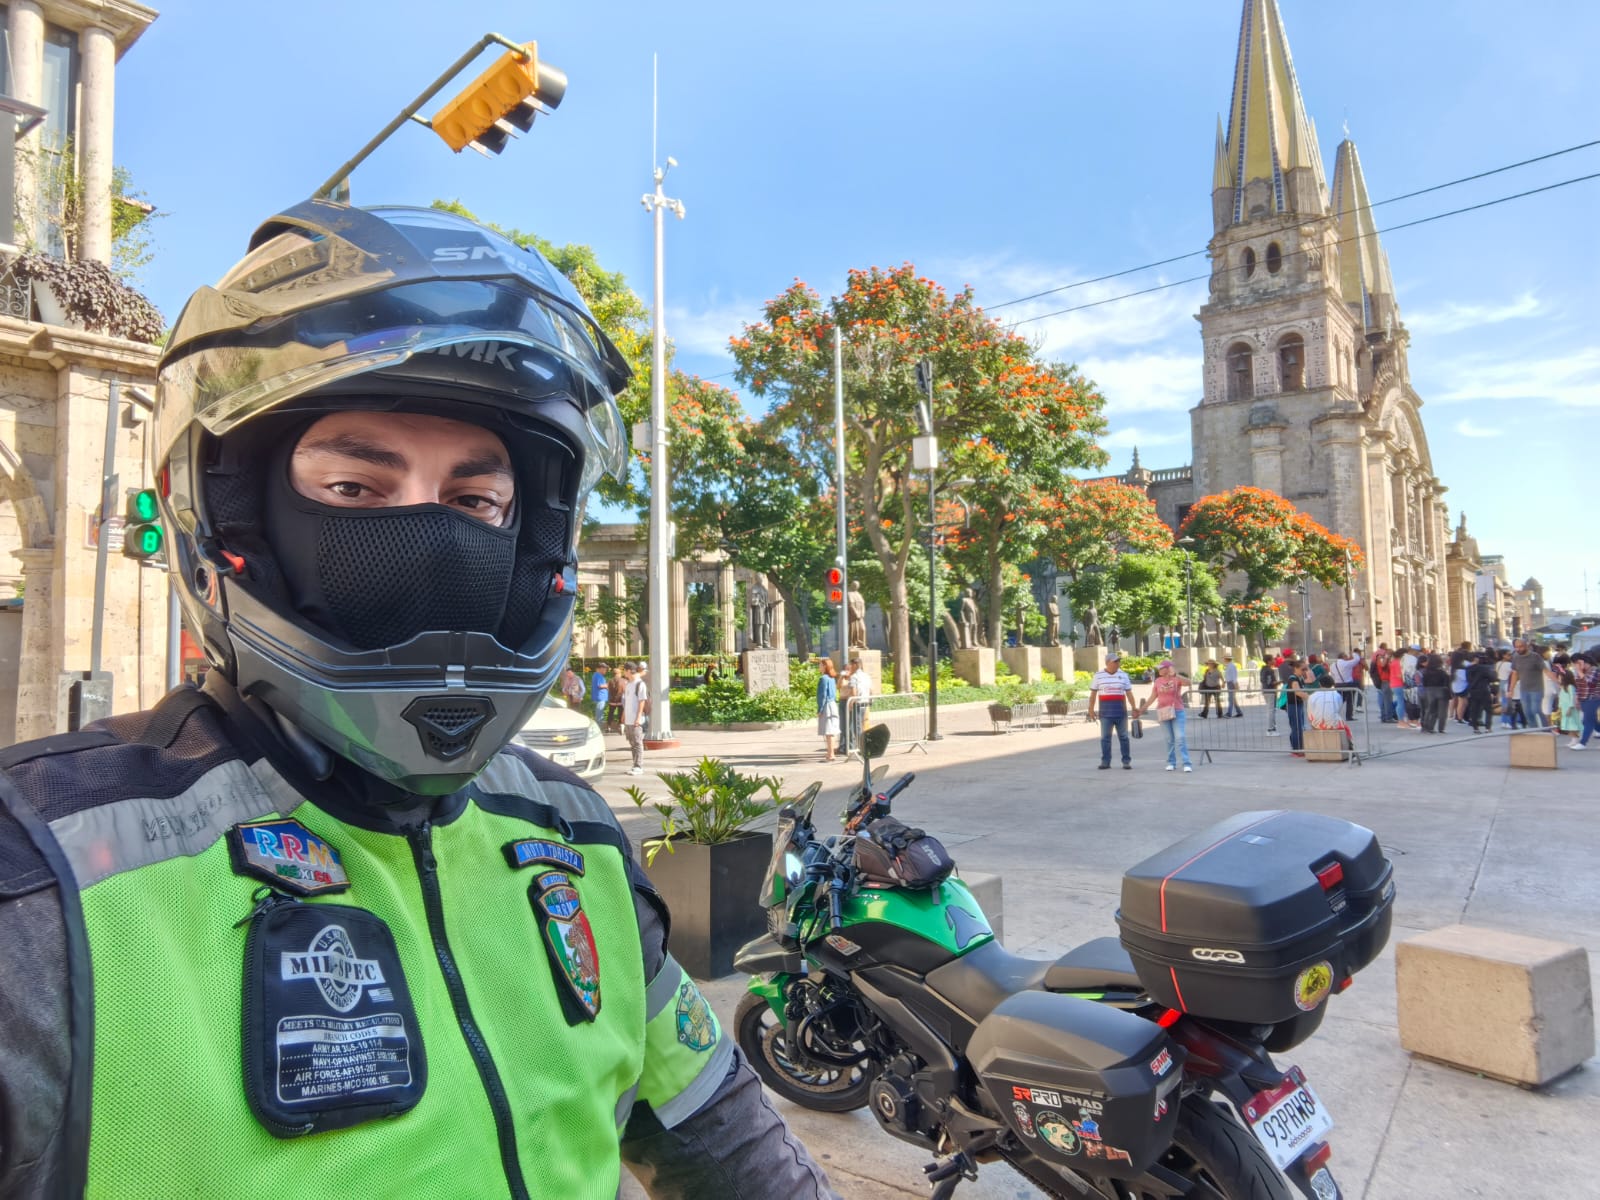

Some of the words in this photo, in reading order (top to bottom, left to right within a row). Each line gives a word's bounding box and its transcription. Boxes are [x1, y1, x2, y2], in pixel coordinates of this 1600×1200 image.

[431, 245, 546, 283] SMK
[253, 828, 337, 872] RRM
[522, 843, 545, 858] MOTO
[290, 955, 377, 981] MIL-SPEC
[283, 1019, 314, 1031] MEETS
[350, 1029, 378, 1040] CODES
[1150, 1047, 1170, 1074] SMK
[294, 1072, 312, 1083] AIR
[1063, 1095, 1103, 1111] SHAD
